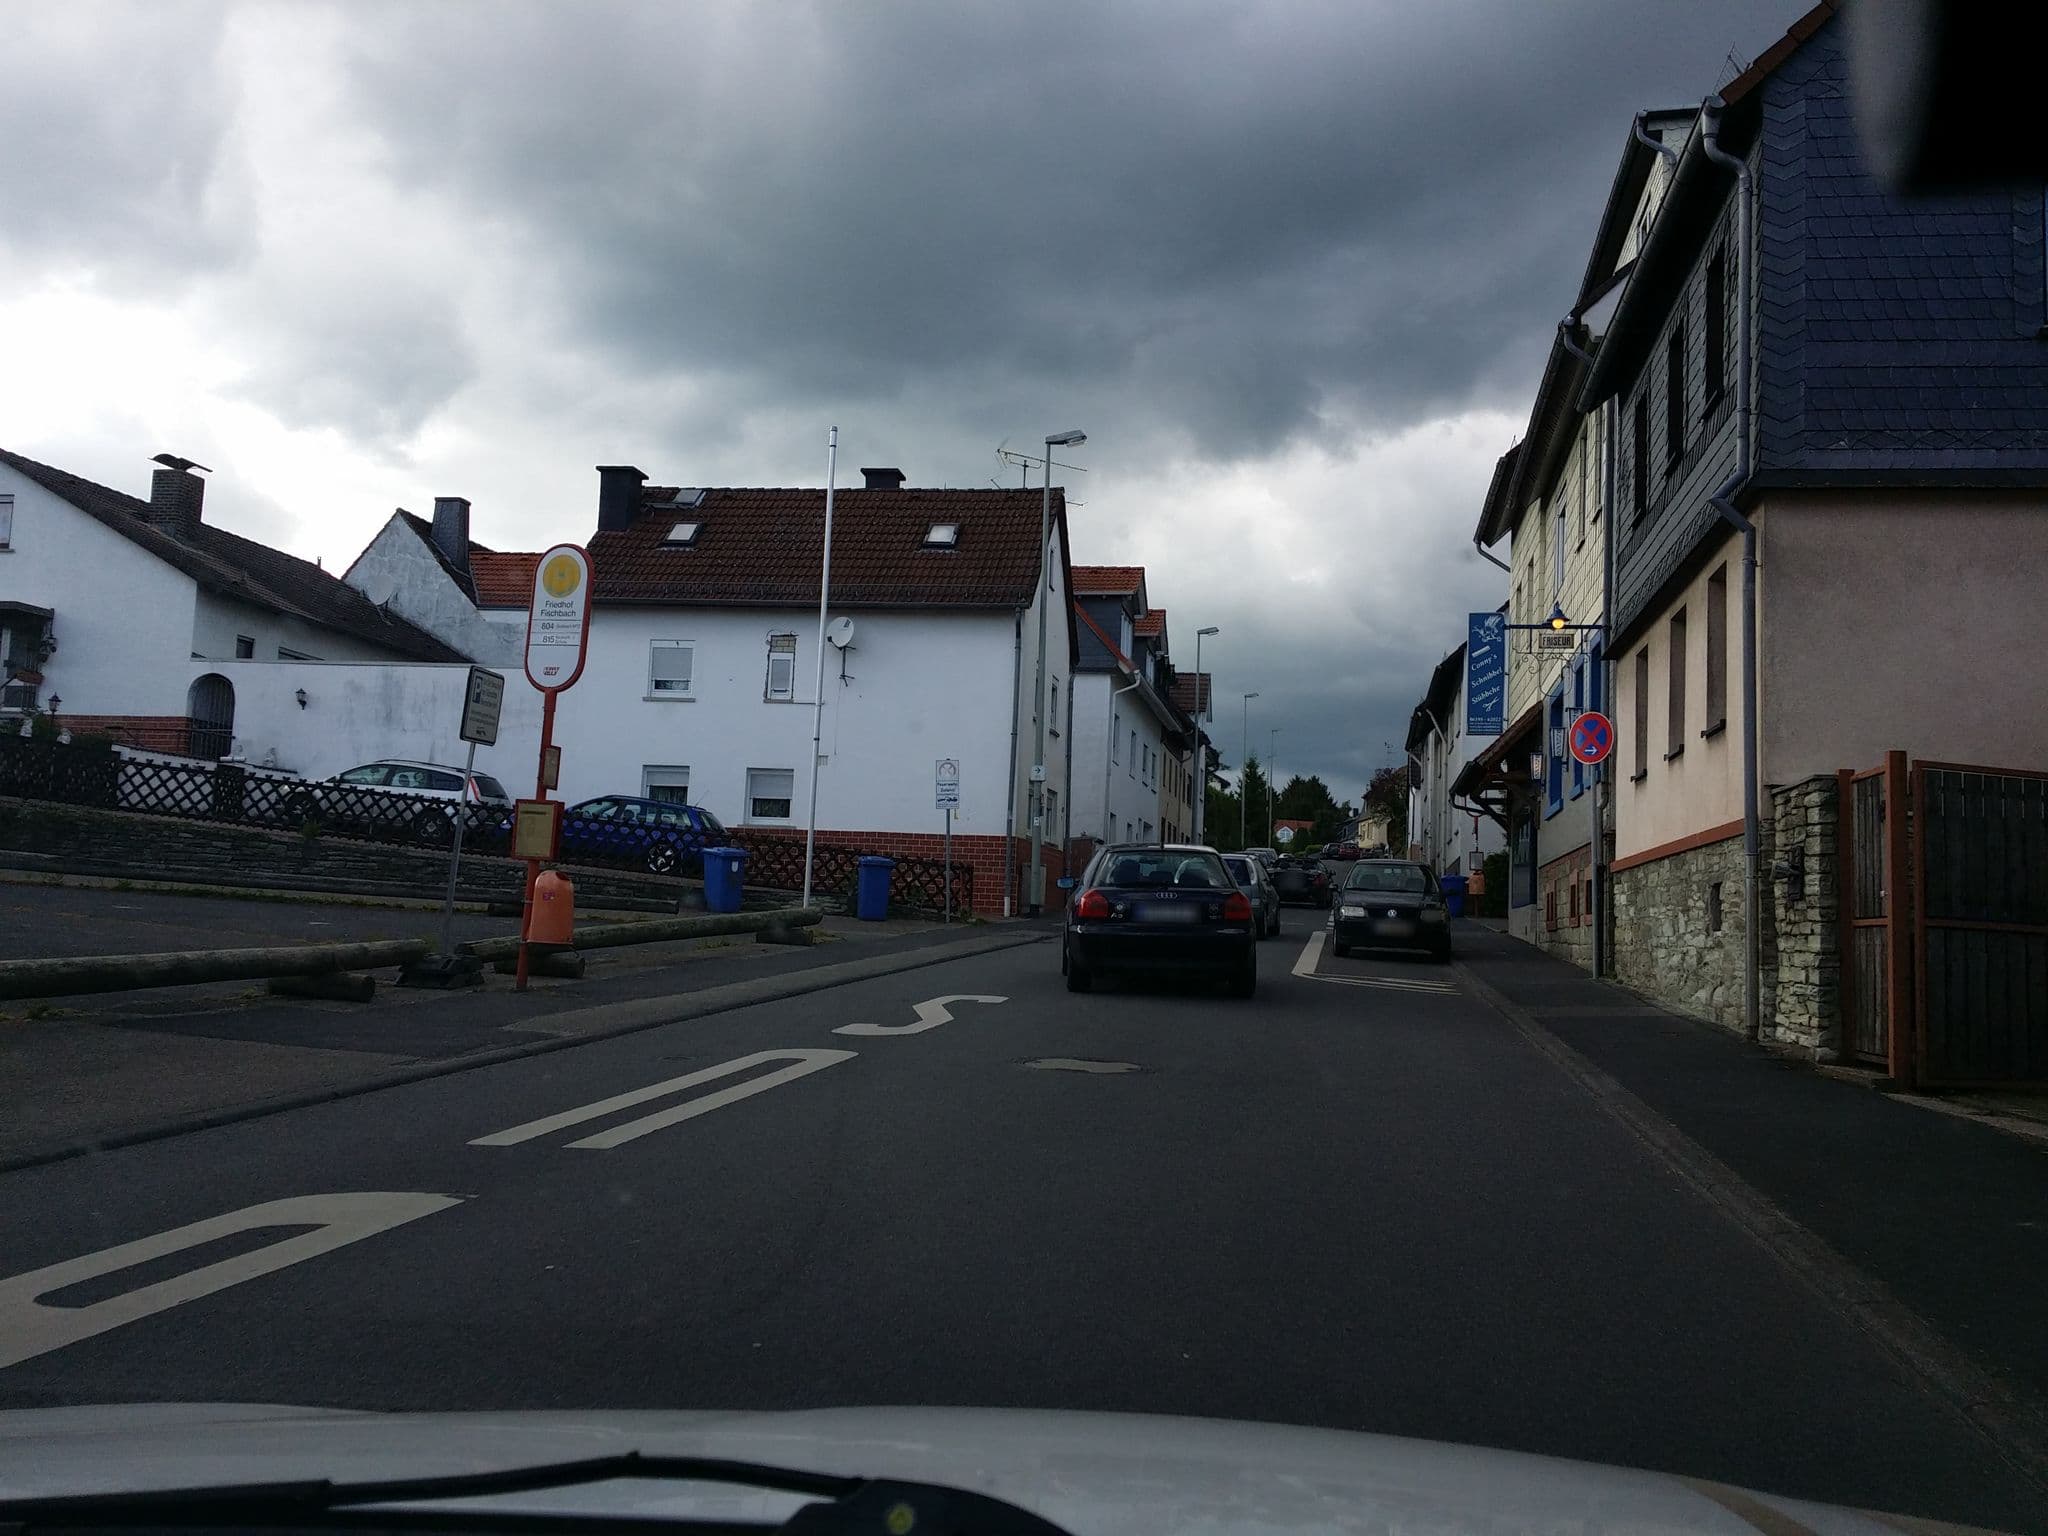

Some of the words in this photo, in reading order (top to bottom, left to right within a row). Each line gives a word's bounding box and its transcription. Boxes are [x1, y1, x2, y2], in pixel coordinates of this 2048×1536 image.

[545, 600, 574, 609] Friedhof
[540, 609, 577, 617] Fischbach
[542, 635, 555, 643] 815
[1542, 635, 1571, 647] FRISEUR
[1471, 652, 1498, 671] Conny's
[1471, 666, 1503, 689] Schnibbel
